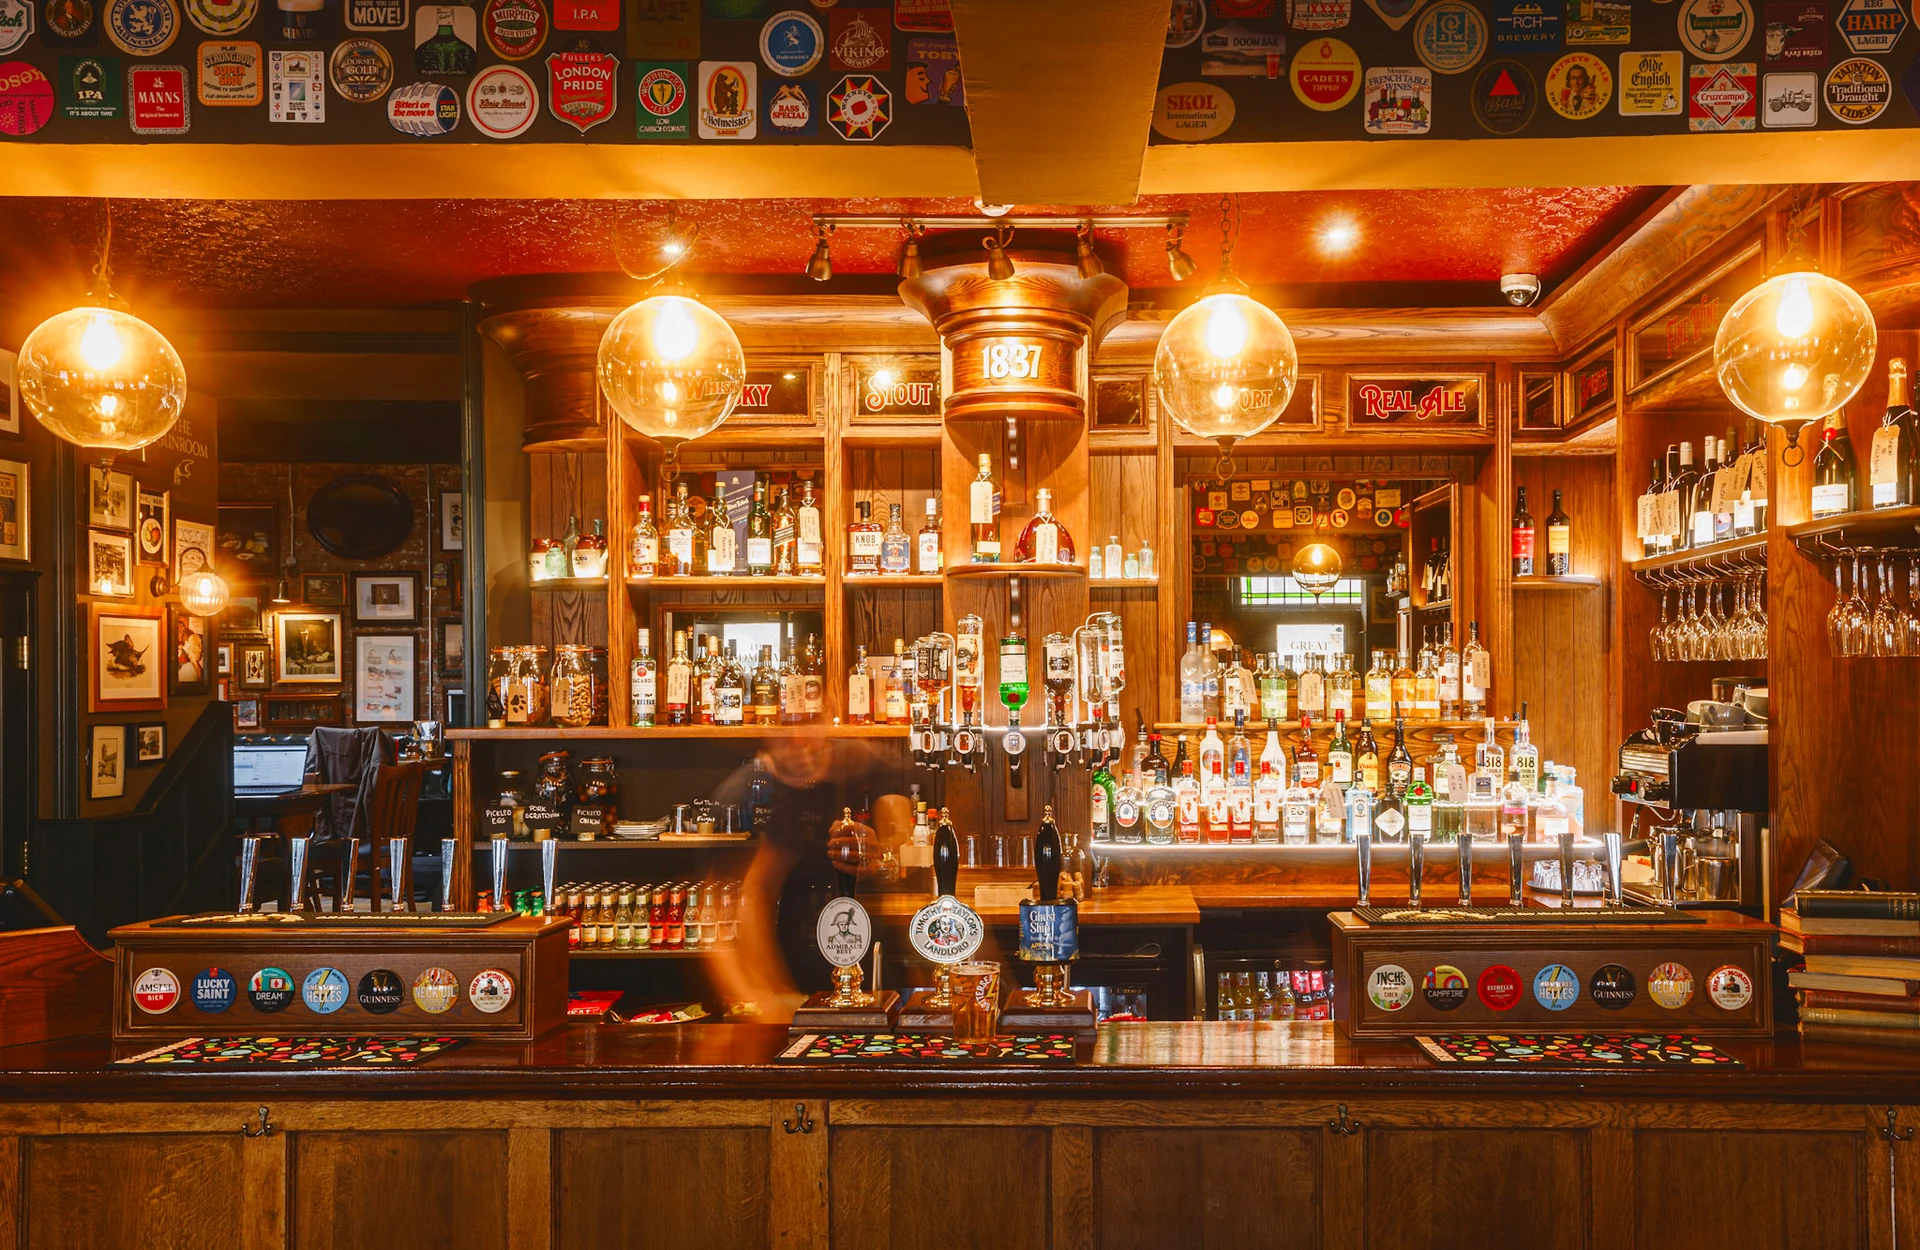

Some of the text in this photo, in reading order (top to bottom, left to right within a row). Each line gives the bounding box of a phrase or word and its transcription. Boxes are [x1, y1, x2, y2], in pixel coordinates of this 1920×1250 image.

[1864, 0, 1883, 8] KEG
[354, 7, 400, 24] MOVE!
[1513, 16, 1543, 28] RCH
[1846, 13, 1902, 31] HARP
[1233, 38, 1260, 46] DOOM
[1498, 33, 1557, 42] BREWERY
[1857, 36, 1888, 45] LAGER
[834, 46, 886, 58] VIKING
[203, 52, 257, 68] STRONGBOW
[845, 57, 876, 67] BREWERY
[1639, 58, 1663, 72] Olde
[214, 66, 247, 76] SUPER
[347, 66, 377, 75] GOLD
[555, 66, 611, 81] LONDON
[1834, 62, 1882, 82] TAUNTON
[219, 76, 243, 86] SHOT
[640, 71, 683, 95] WORTHINGTON
[1303, 75, 1349, 83] CADETS
[1369, 75, 1429, 86] FRENCH TABLE
[1631, 71, 1671, 88] English
[340, 84, 370, 99] GOLDEN
[563, 81, 604, 91] PRIDE
[1385, 83, 1413, 91] WINES
[1830, 84, 1886, 94] Traditional
[78, 90, 104, 100] IPA
[138, 92, 180, 104] MANNS
[841, 89, 873, 111] WATNEYS
[1701, 92, 1745, 102] Cruzcampo
[1836, 92, 1879, 103] Draught
[394, 101, 419, 109] Bitter's
[1167, 95, 1217, 110] SKOL
[426, 109, 435, 117] to
[653, 105, 672, 113] LITE
[778, 105, 799, 113] BASS
[1839, 105, 1875, 119] CIDER
[773, 111, 807, 120] SPECIAL
[1167, 111, 1217, 119] International
[708, 115, 747, 128] Hofmeister
[980, 345, 1043, 380] 1837
[866, 373, 933, 413] STOUT
[1358, 383, 1467, 421] REAL ALE
[855, 534, 876, 544] KNOB
[1517, 756, 1535, 768] 818
[486, 809, 511, 817] PICKLED
[916, 905, 978, 937] TIMOTHY TAYLOR'S
[1030, 911, 1056, 922] Ghost
[1030, 922, 1050, 935] Ship
[924, 941, 970, 956] LANDLORD
[197, 979, 230, 989] LUCKY
[1376, 971, 1407, 986] INCH'S
[1651, 980, 1693, 993] NECK OIL
[197, 989, 230, 999] SAINT
[256, 992, 283, 1000] DREAM
[306, 990, 342, 1002] HELLES
[359, 995, 400, 1004] GUINNESS
[1427, 990, 1464, 998] CAMPFIRE
[1539, 988, 1574, 1000] HELLES
[1593, 989, 1634, 999] GUINNESS
